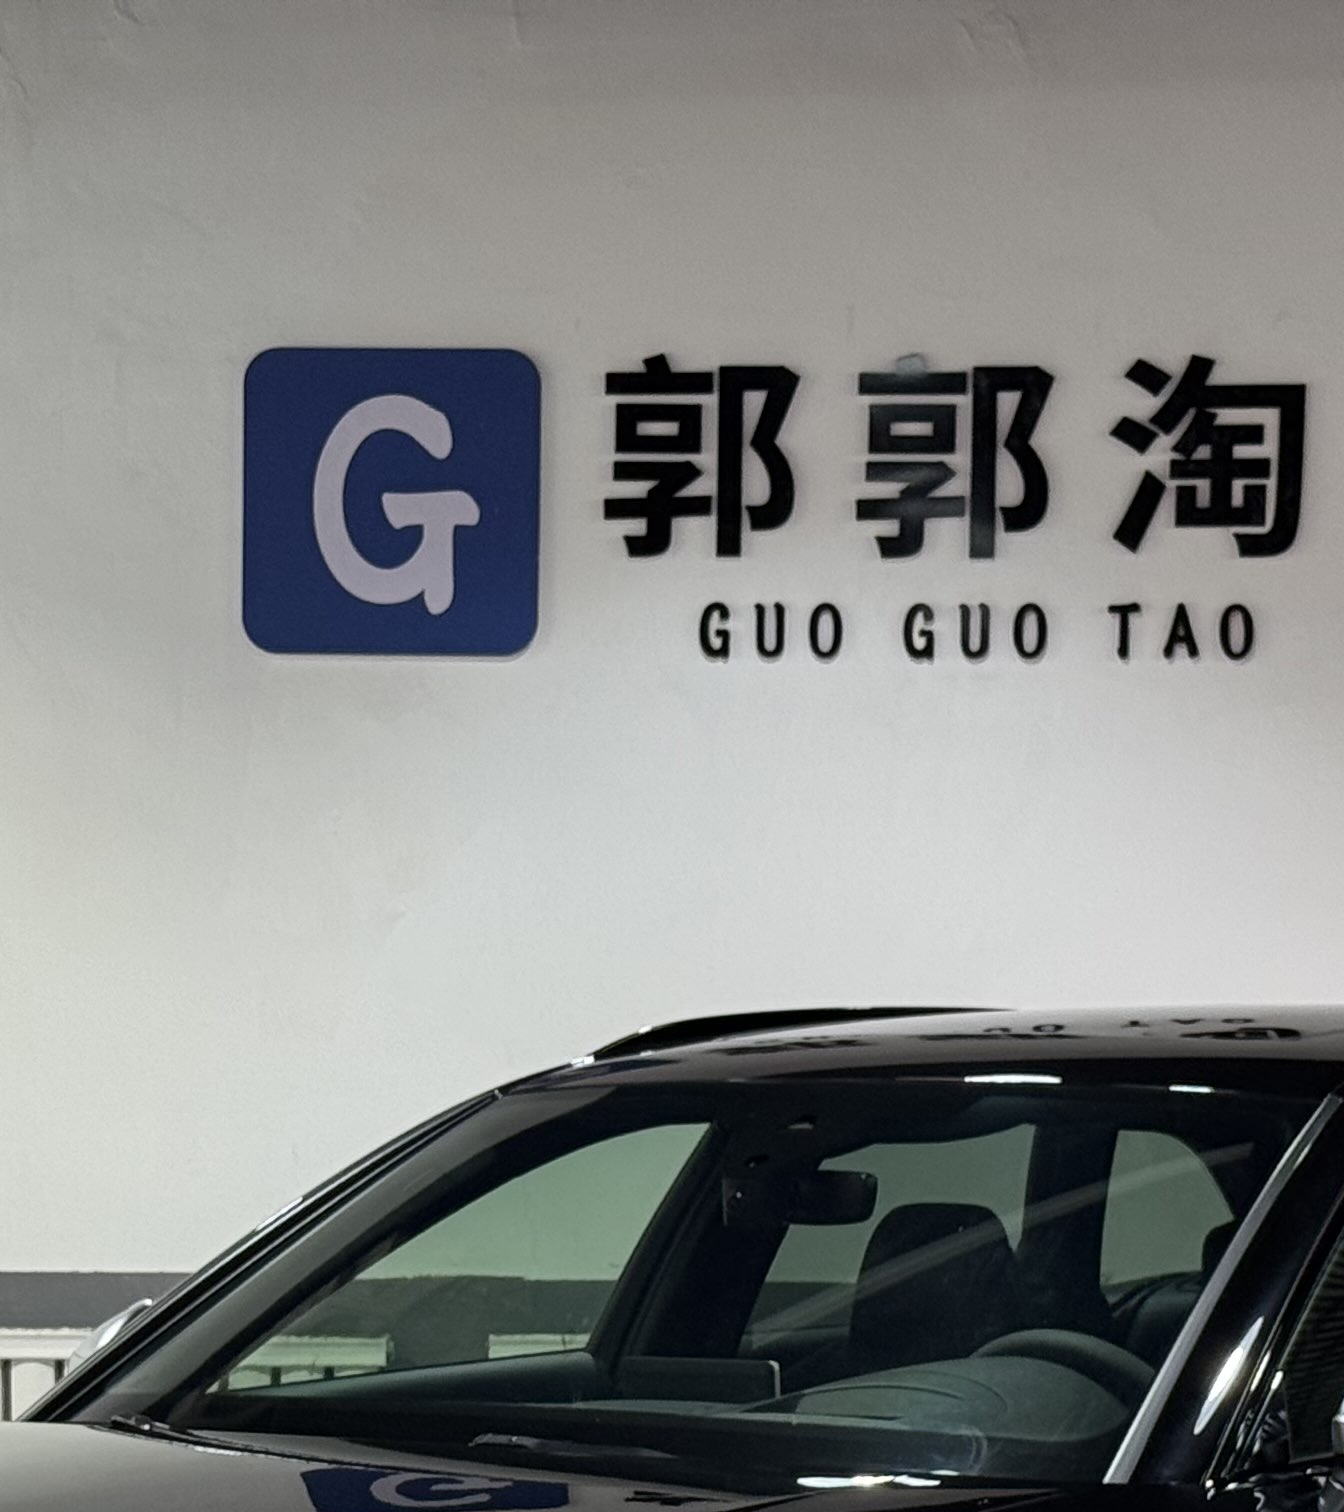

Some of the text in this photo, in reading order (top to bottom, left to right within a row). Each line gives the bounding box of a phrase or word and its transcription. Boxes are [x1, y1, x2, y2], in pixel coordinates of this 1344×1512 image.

[313, 394, 480, 615] G
[698, 601, 844, 660] GUO
[902, 602, 1049, 661] GUO
[1106, 601, 1256, 661] TAO
